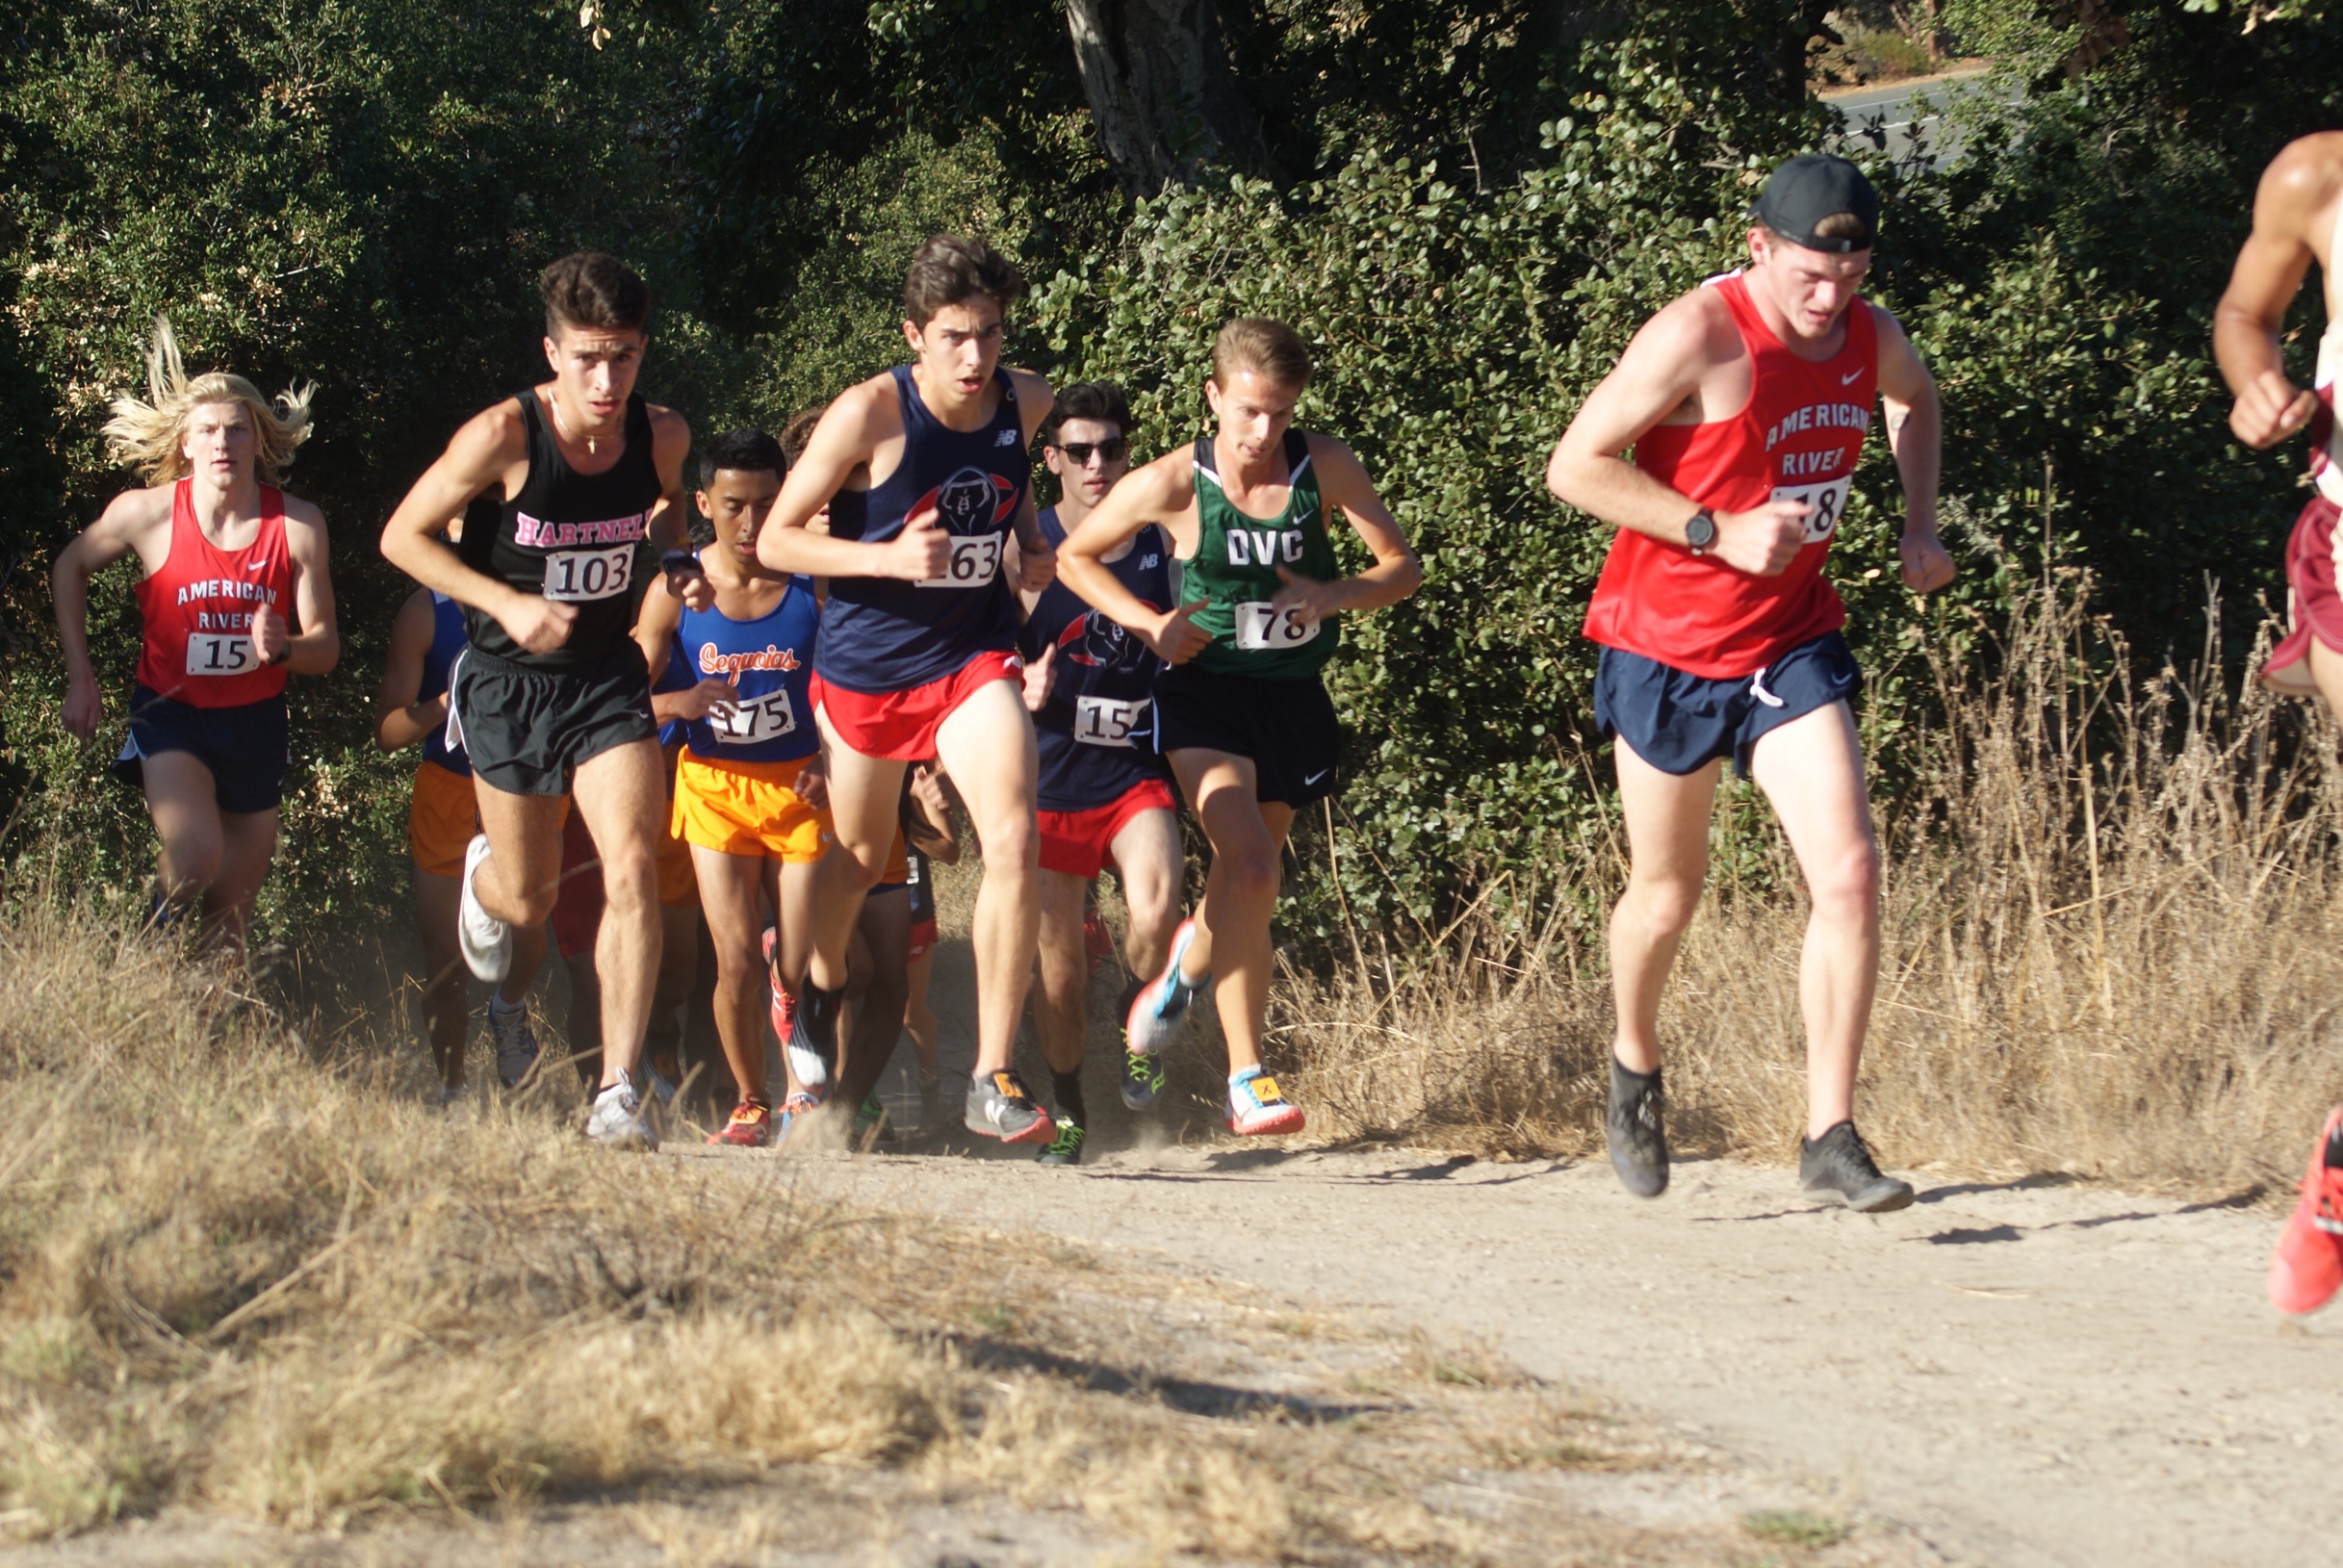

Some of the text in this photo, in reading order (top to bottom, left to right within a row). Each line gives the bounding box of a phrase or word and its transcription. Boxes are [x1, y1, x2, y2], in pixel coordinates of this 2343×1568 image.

[1764, 403, 1869, 451] AMERICAN
[1782, 447, 1845, 476] RIVER
[515, 508, 654, 548] HARTNEL
[1226, 528, 1304, 566] DVC
[555, 553, 629, 595] 103
[940, 541, 997, 580] 63
[177, 579, 277, 606] AMERICAN
[198, 612, 253, 630] RIVER
[1257, 607, 1306, 641] 78
[204, 640, 248, 670] 15
[699, 642, 802, 687] Sequoias
[718, 694, 788, 737] 175
